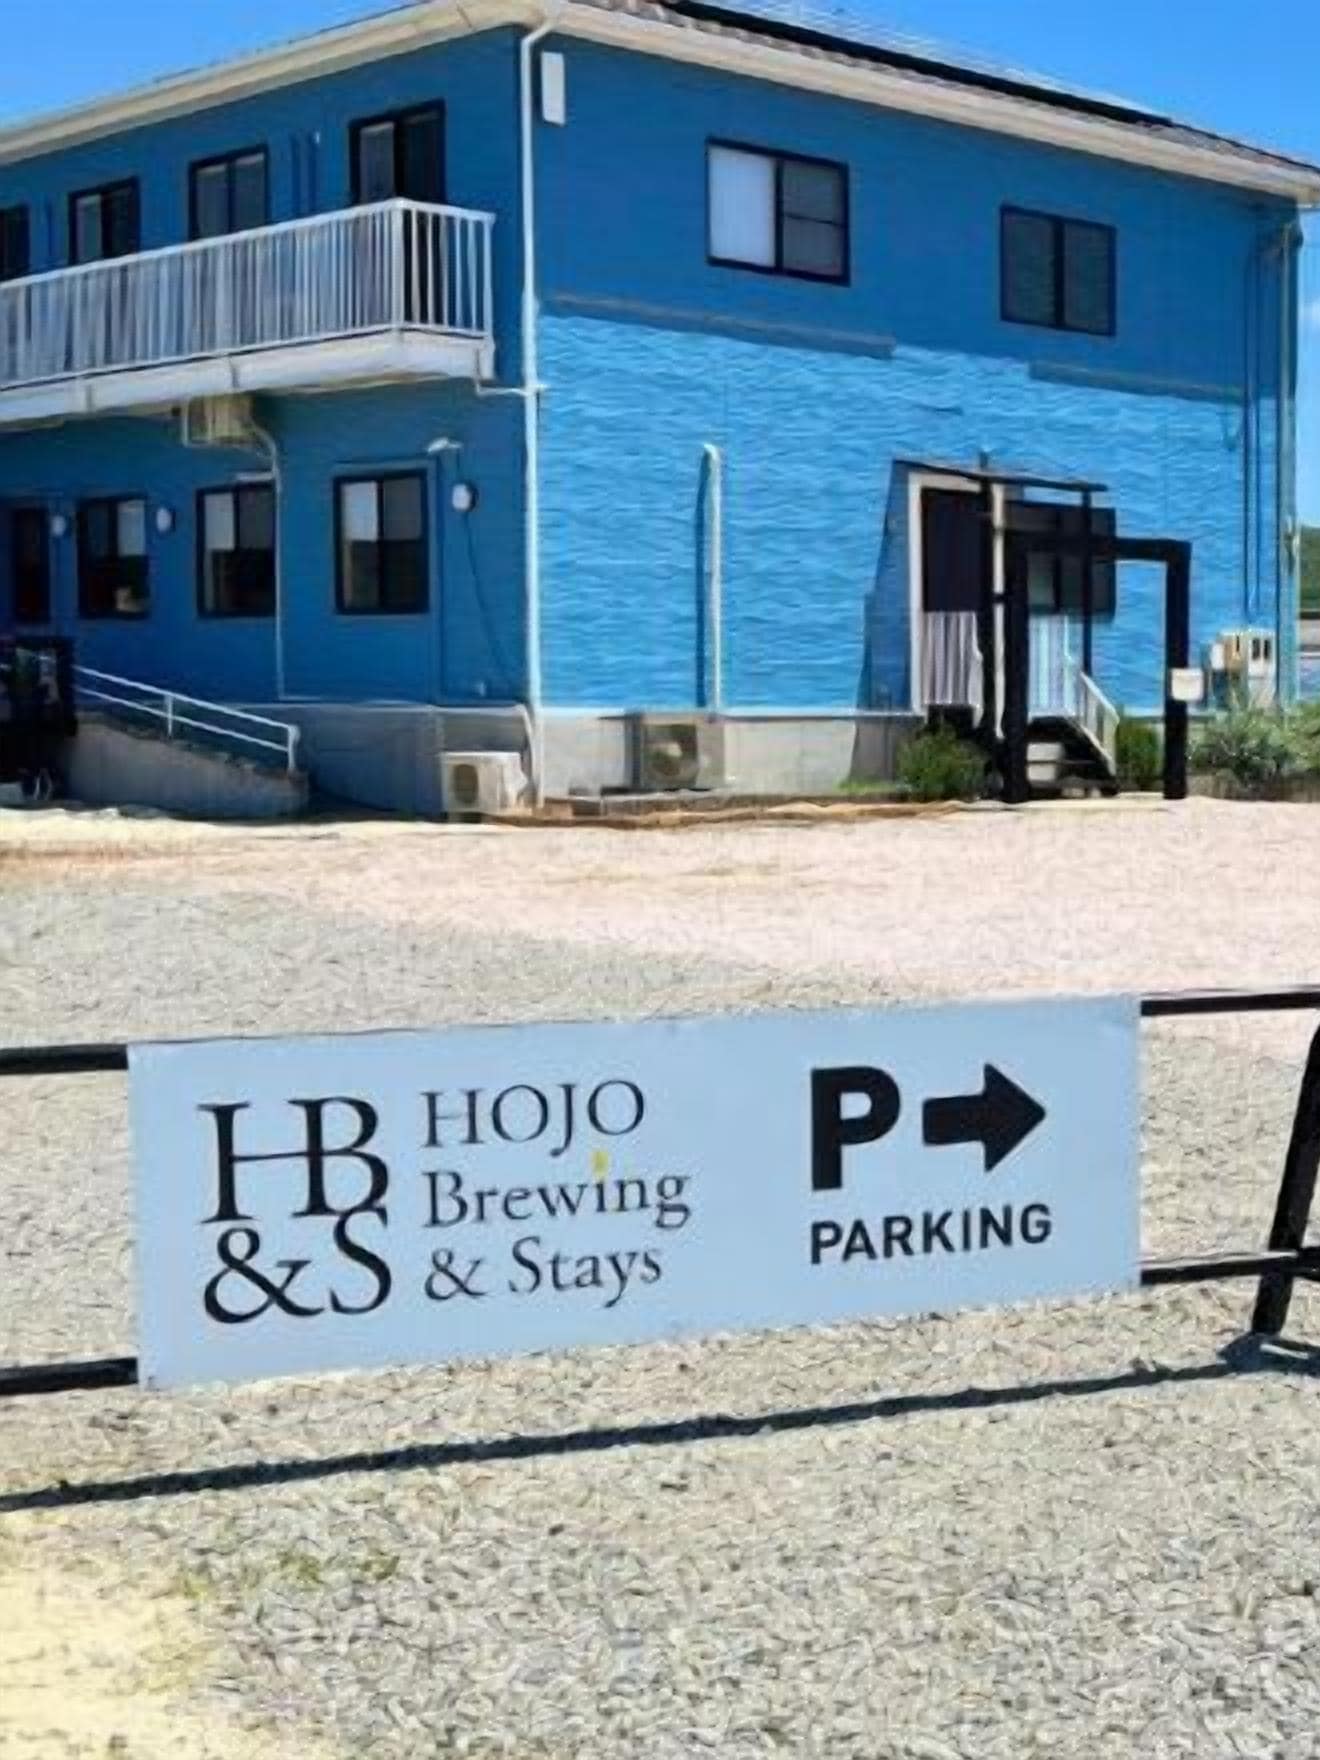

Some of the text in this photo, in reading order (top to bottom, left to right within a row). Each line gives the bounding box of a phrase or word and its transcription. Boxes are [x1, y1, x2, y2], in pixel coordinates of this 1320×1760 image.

[421, 1078, 646, 1158] HOJO
[810, 1065, 902, 1192] P
[423, 1151, 691, 1230] Brewing
[424, 1235, 662, 1309] & Stays
[810, 1203, 1052, 1265] PARKING
